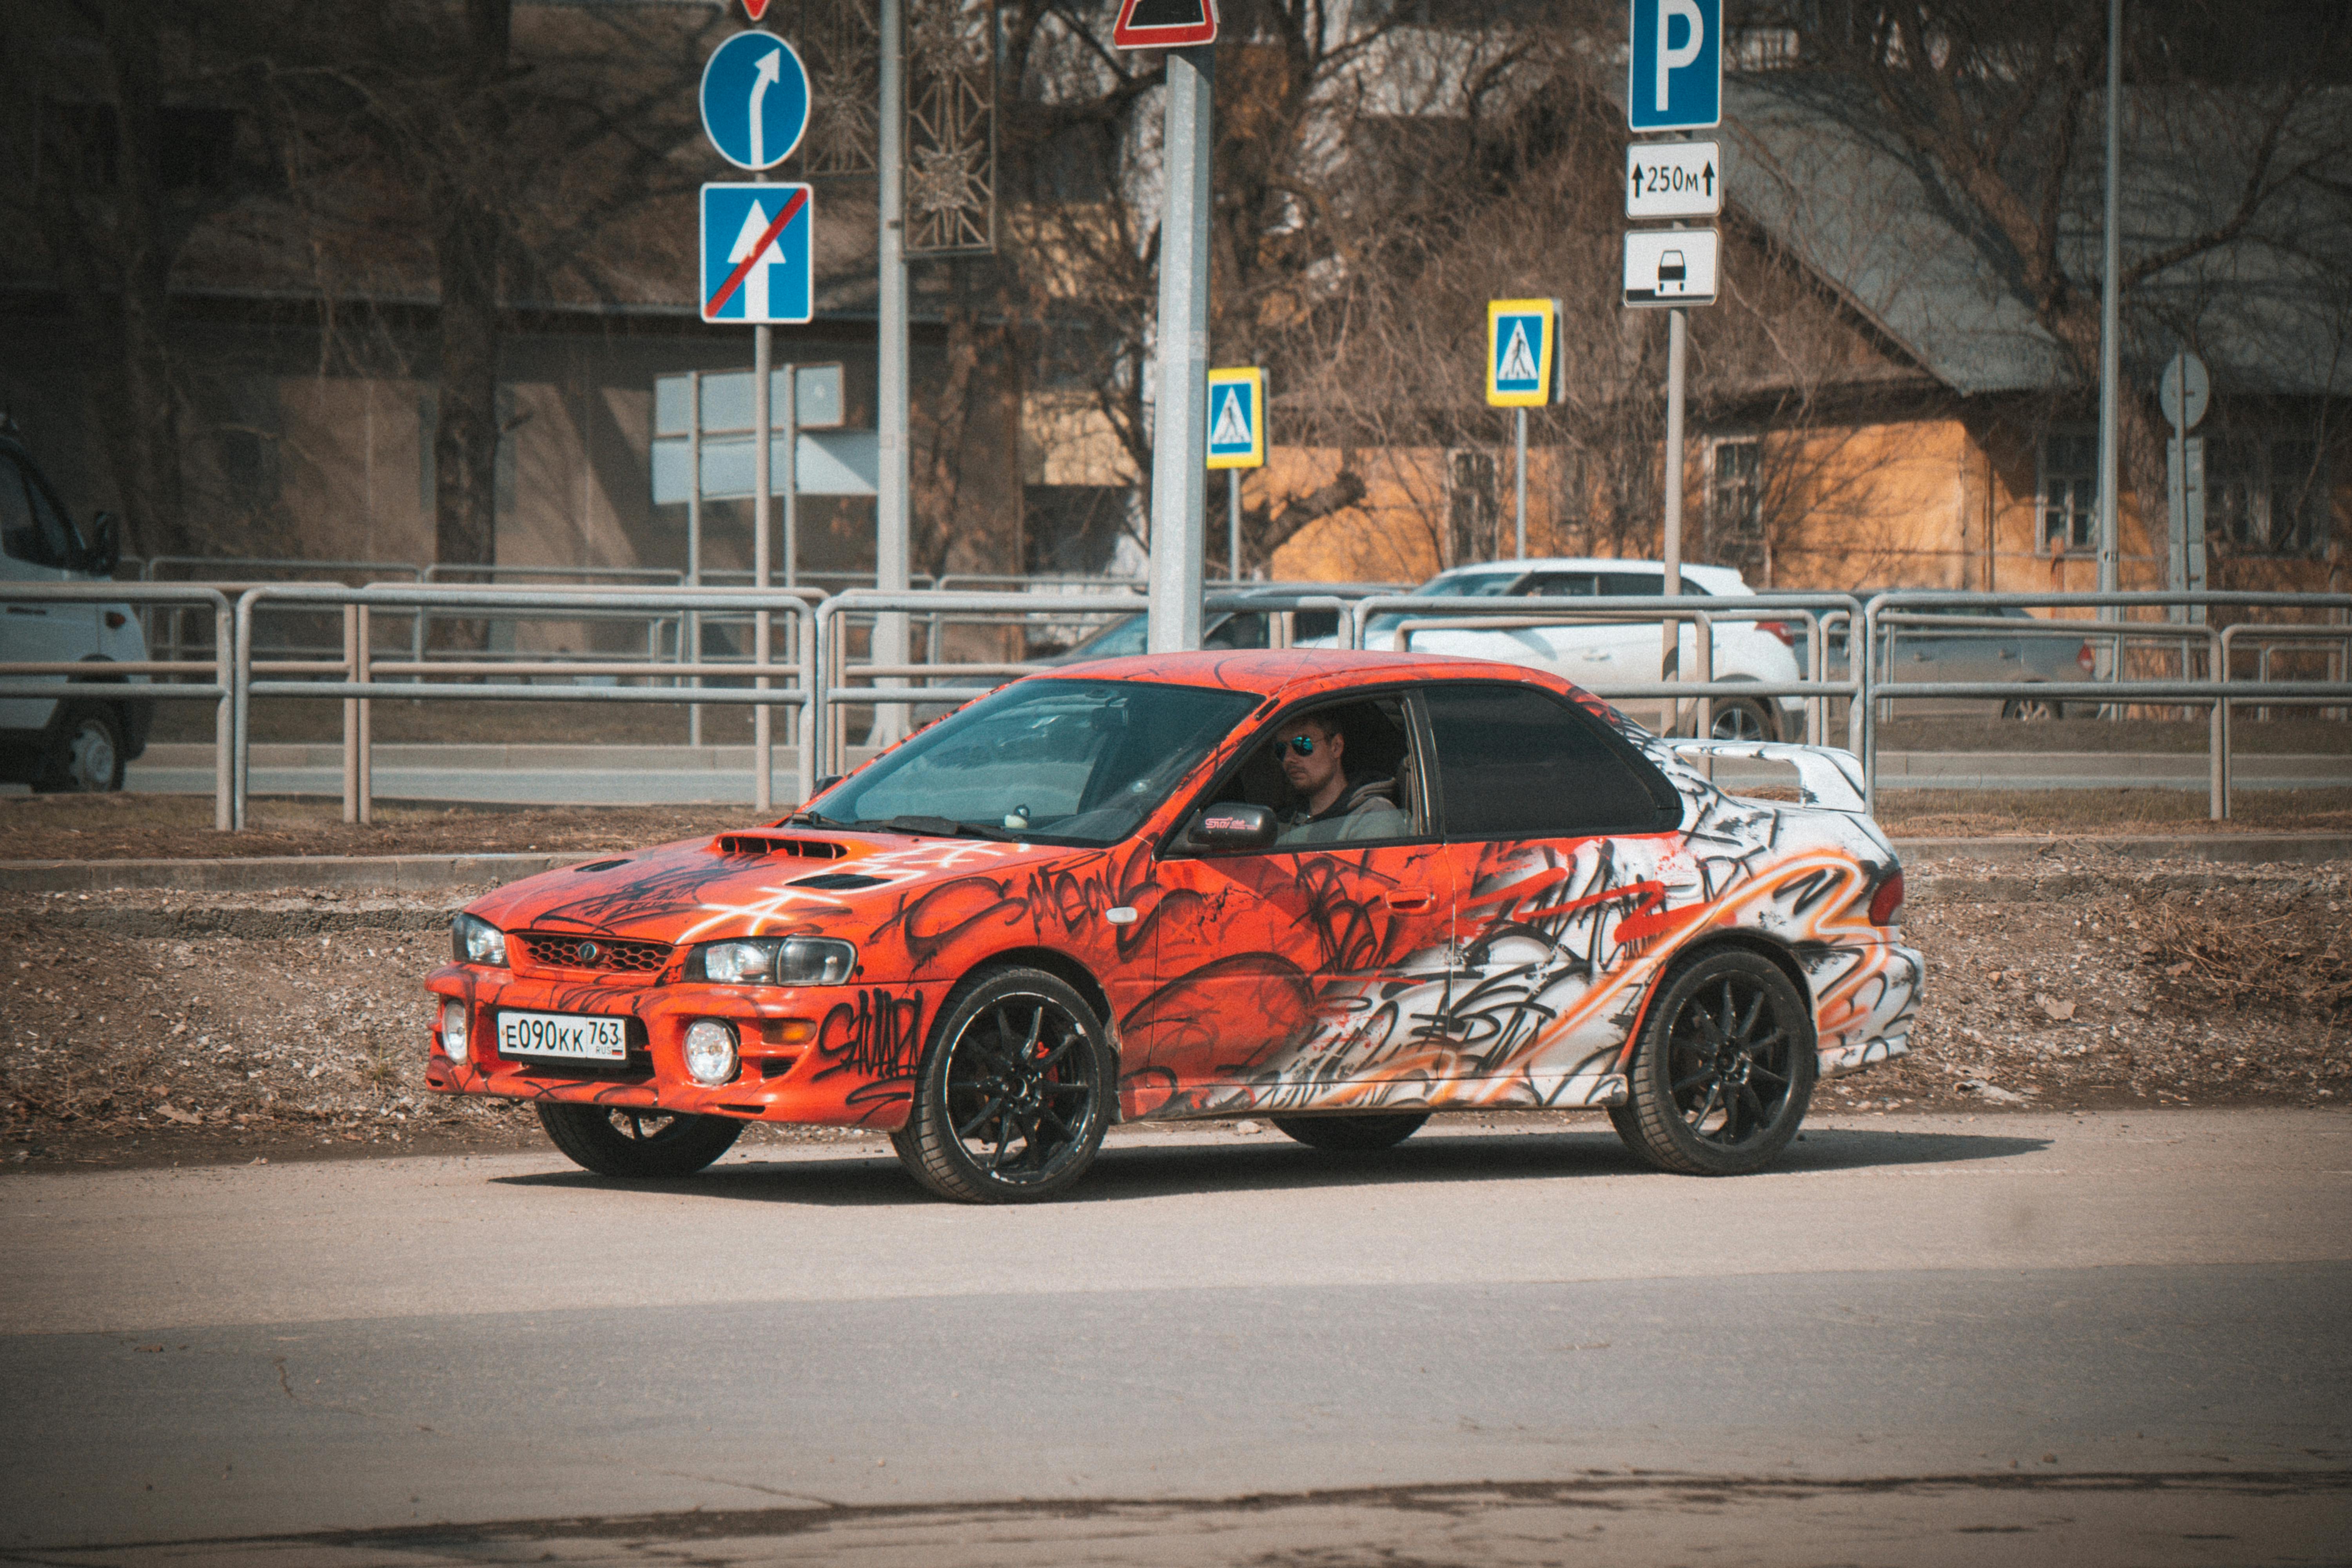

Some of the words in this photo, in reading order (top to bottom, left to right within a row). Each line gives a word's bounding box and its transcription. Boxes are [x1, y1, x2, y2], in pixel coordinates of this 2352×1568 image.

[1656, 0, 1704, 111] P
[589, 1022, 619, 1045] 763
[596, 1046, 612, 1055] RUS
